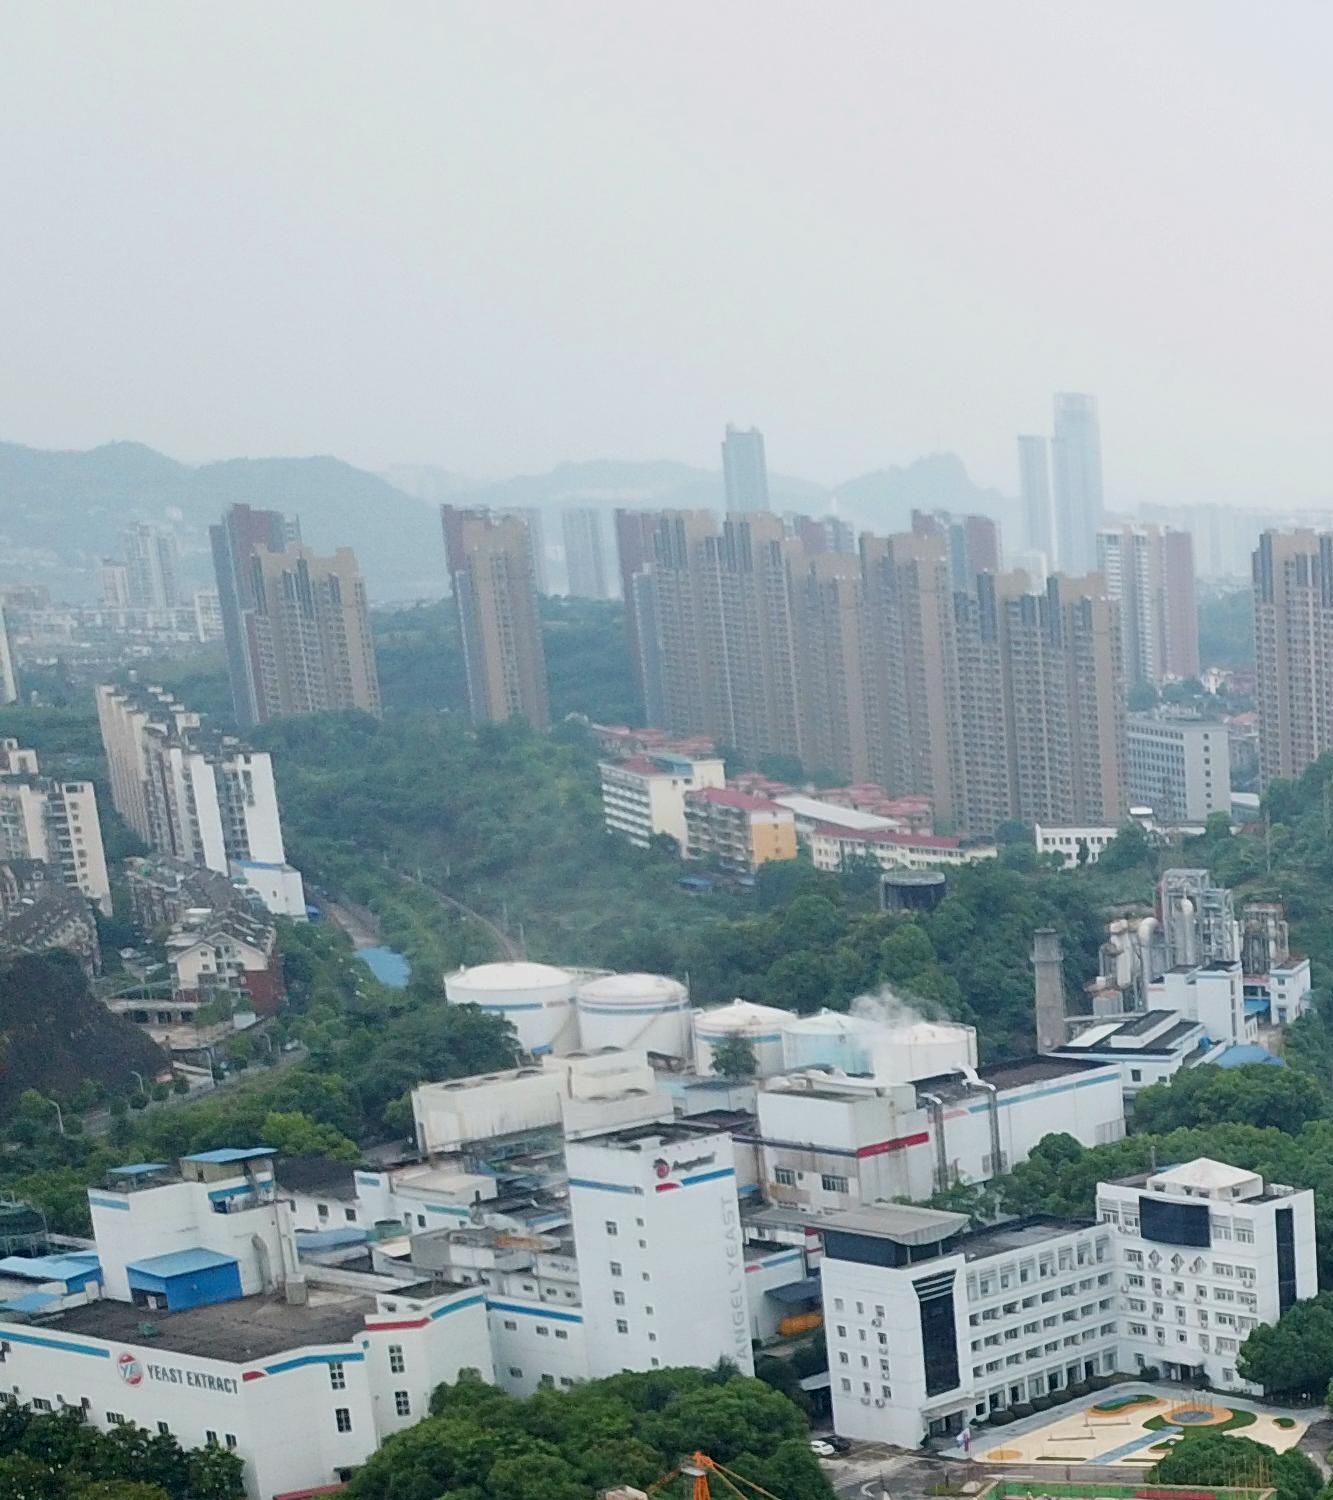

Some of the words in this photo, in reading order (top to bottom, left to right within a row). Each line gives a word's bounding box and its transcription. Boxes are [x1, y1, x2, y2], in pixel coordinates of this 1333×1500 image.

[721, 1197, 739, 1275] YEAST
[731, 1281, 748, 1360] ANGEL
[147, 1364, 183, 1384] YEAST
[186, 1371, 239, 1394] EXTRACT
